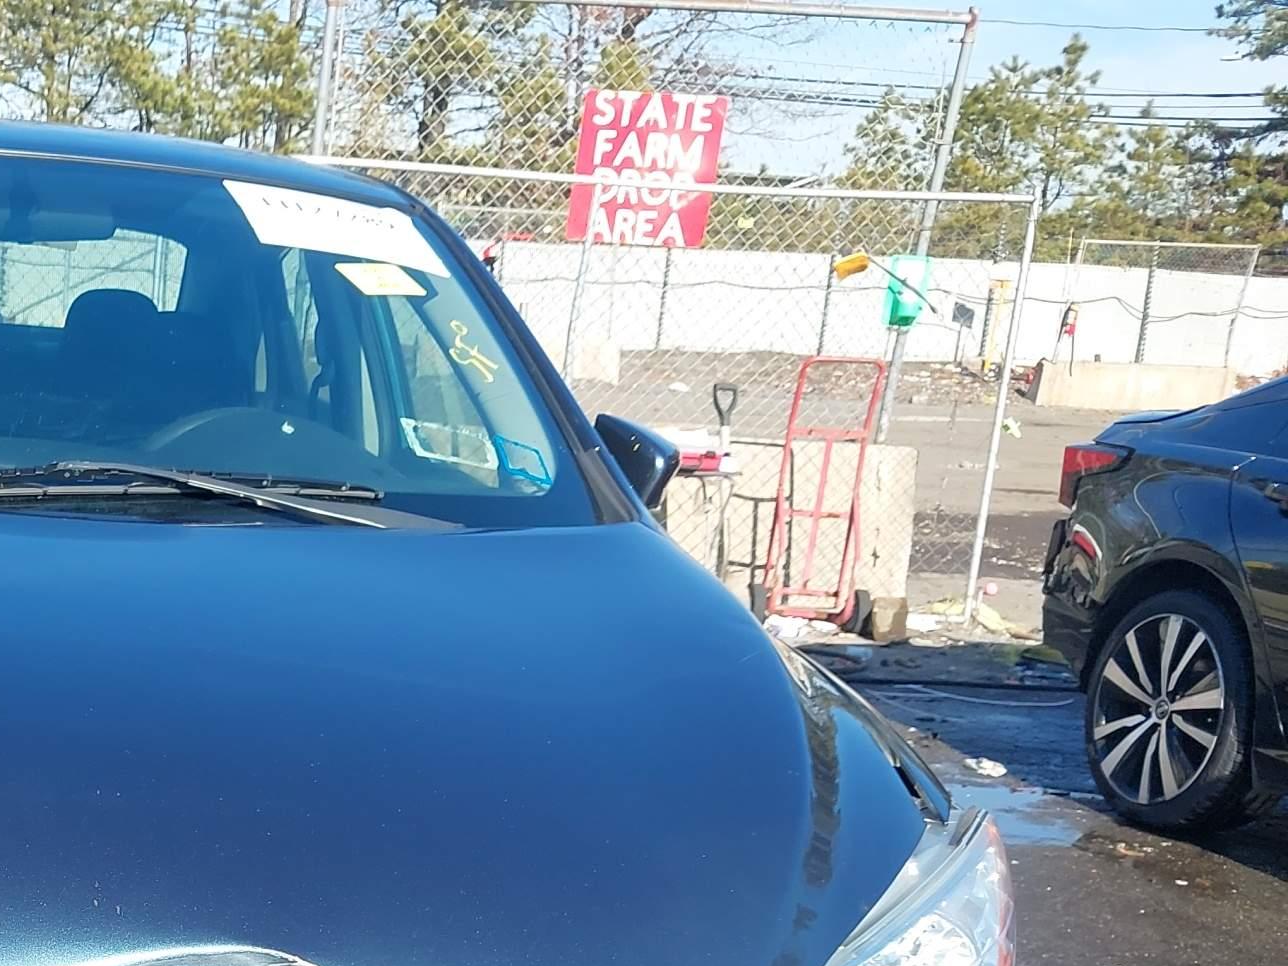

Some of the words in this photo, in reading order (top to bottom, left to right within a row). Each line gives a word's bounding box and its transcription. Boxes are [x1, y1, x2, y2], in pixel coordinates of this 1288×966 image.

[592, 91, 717, 132] STATE
[593, 129, 705, 171] FARM
[589, 207, 686, 248] AREA
